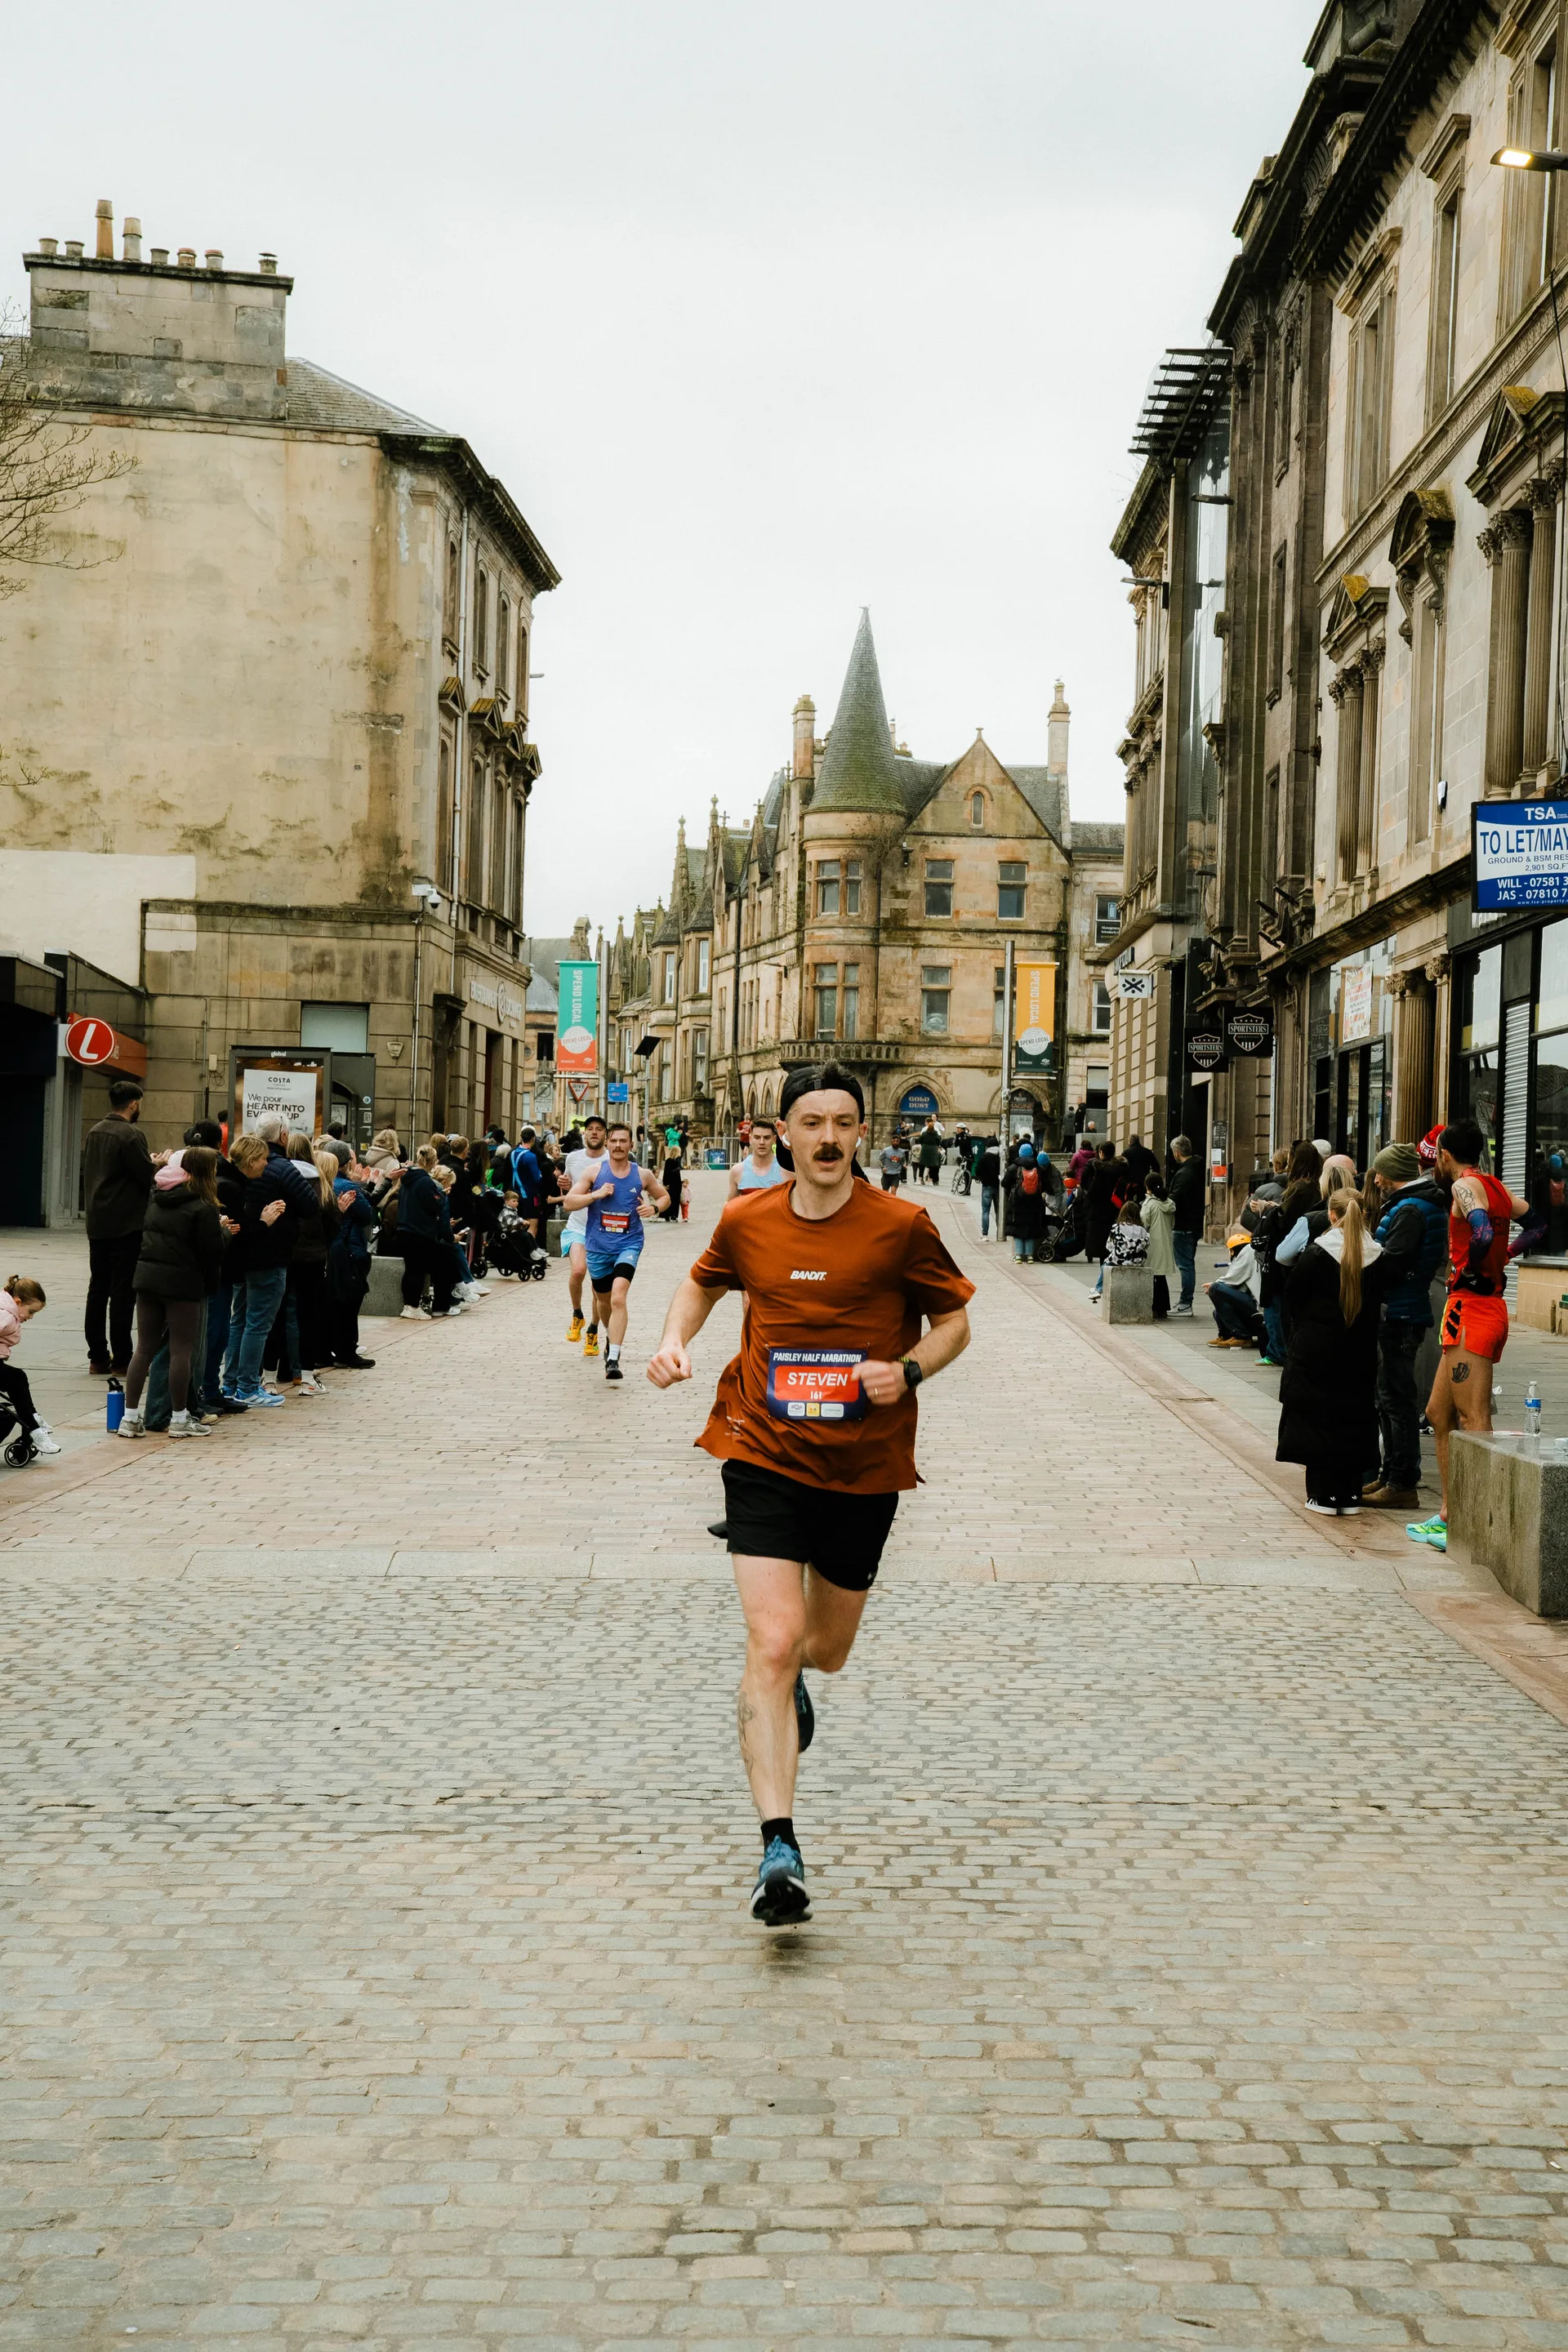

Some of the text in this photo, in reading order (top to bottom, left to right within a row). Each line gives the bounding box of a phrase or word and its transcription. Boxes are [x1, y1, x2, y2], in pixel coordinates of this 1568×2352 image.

[1525, 806, 1557, 820] TSA
[1480, 831, 1501, 854] TO
[1488, 856, 1523, 864] GROUND
[1548, 862, 1568, 871] SQ.F
[1497, 878, 1521, 889] WILL
[1530, 876, 1559, 887] 07581
[1497, 890, 1516, 901] JAS
[1526, 889, 1558, 899] 07810
[1561, 889, 1567, 898] 7
[572, 969, 583, 1024] SPEND LOCAL
[1030, 970, 1040, 1025] SPEND LOCAL
[1230, 1025, 1267, 1033] SPORTSTERS
[563, 1037, 577, 1045] SPEND
[248, 1094, 261, 1102] We
[247, 1102, 305, 1113] HEART INTO
[773, 1352, 862, 1363] PAISLEY HALF MARATHON
[786, 1372, 849, 1387] STEVEN
[810, 1391, 822, 1400] 161
